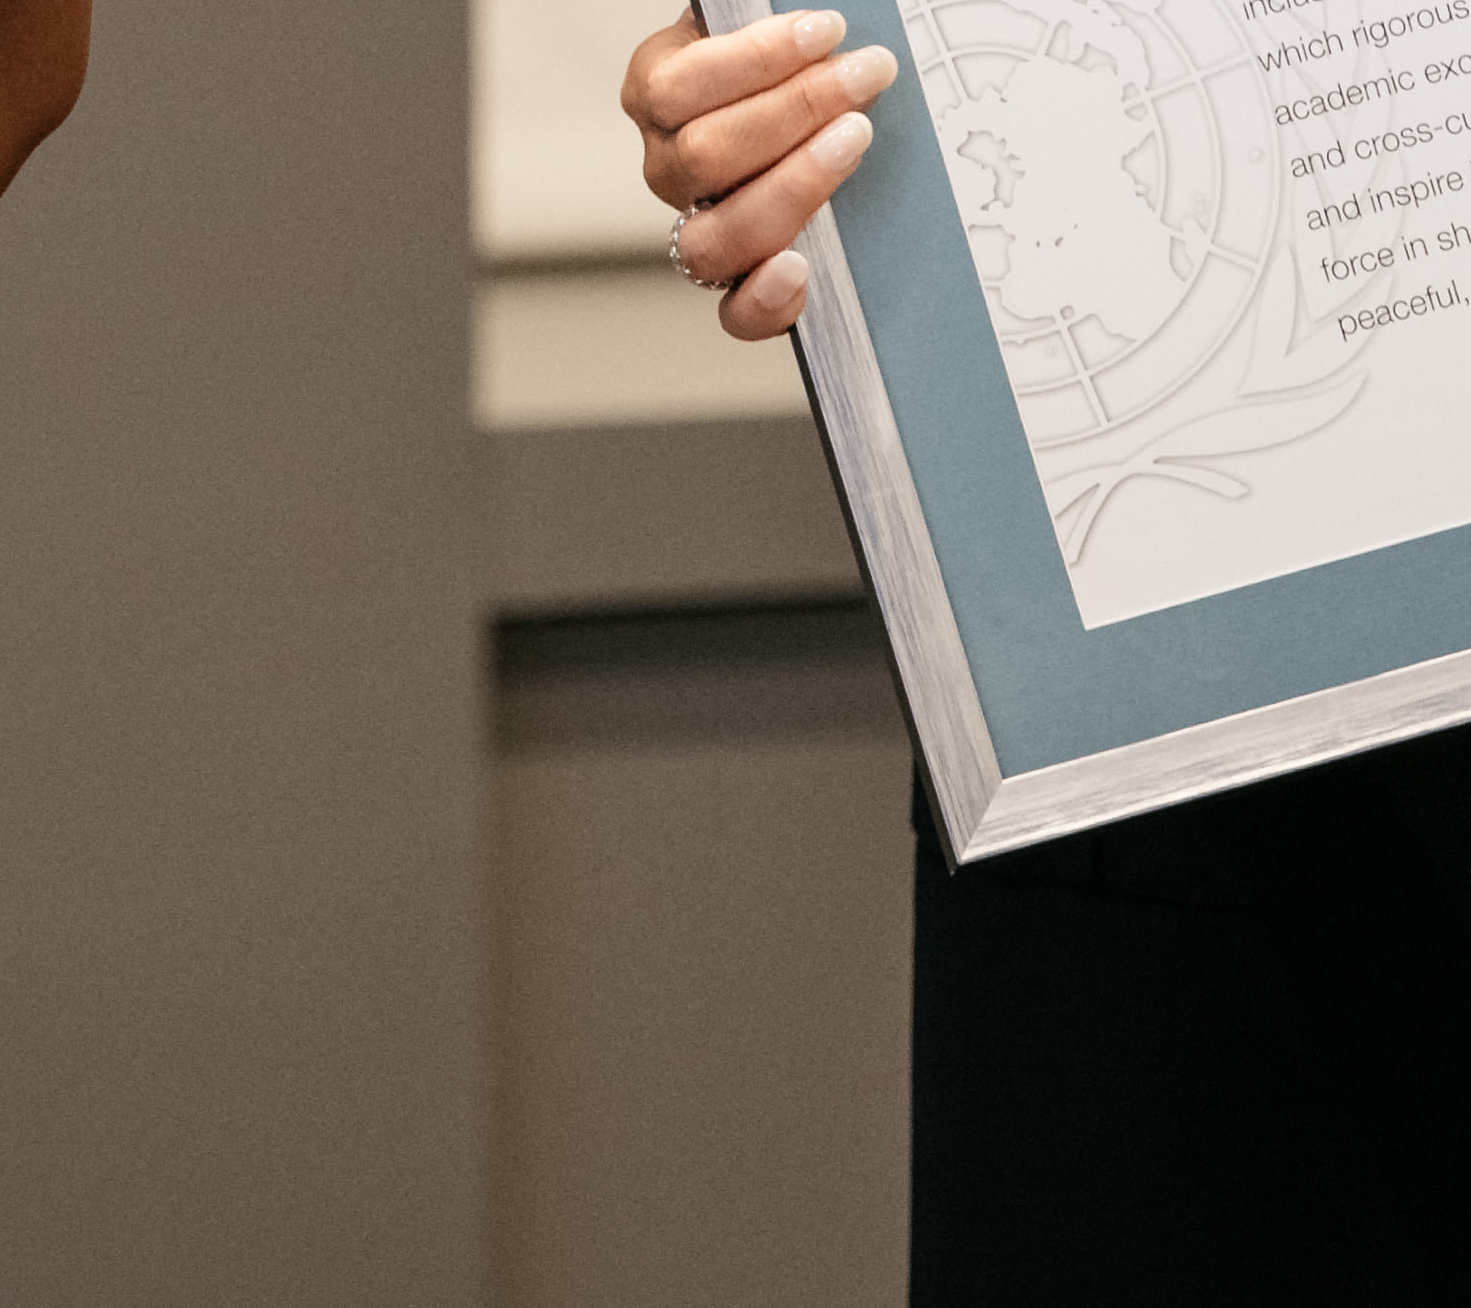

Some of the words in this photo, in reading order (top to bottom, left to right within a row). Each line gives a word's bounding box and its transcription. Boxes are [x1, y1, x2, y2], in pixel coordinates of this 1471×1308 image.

[1257, 30, 1344, 73] which
[1352, 0, 1470, 49] rigorous
[1274, 71, 1416, 126] academic
[1290, 139, 1346, 178] and
[1306, 192, 1362, 231] and
[1369, 171, 1464, 213] inspire
[1321, 247, 1395, 282] force
[1403, 238, 1429, 261] in
[1337, 279, 1470, 343] peaceful,
